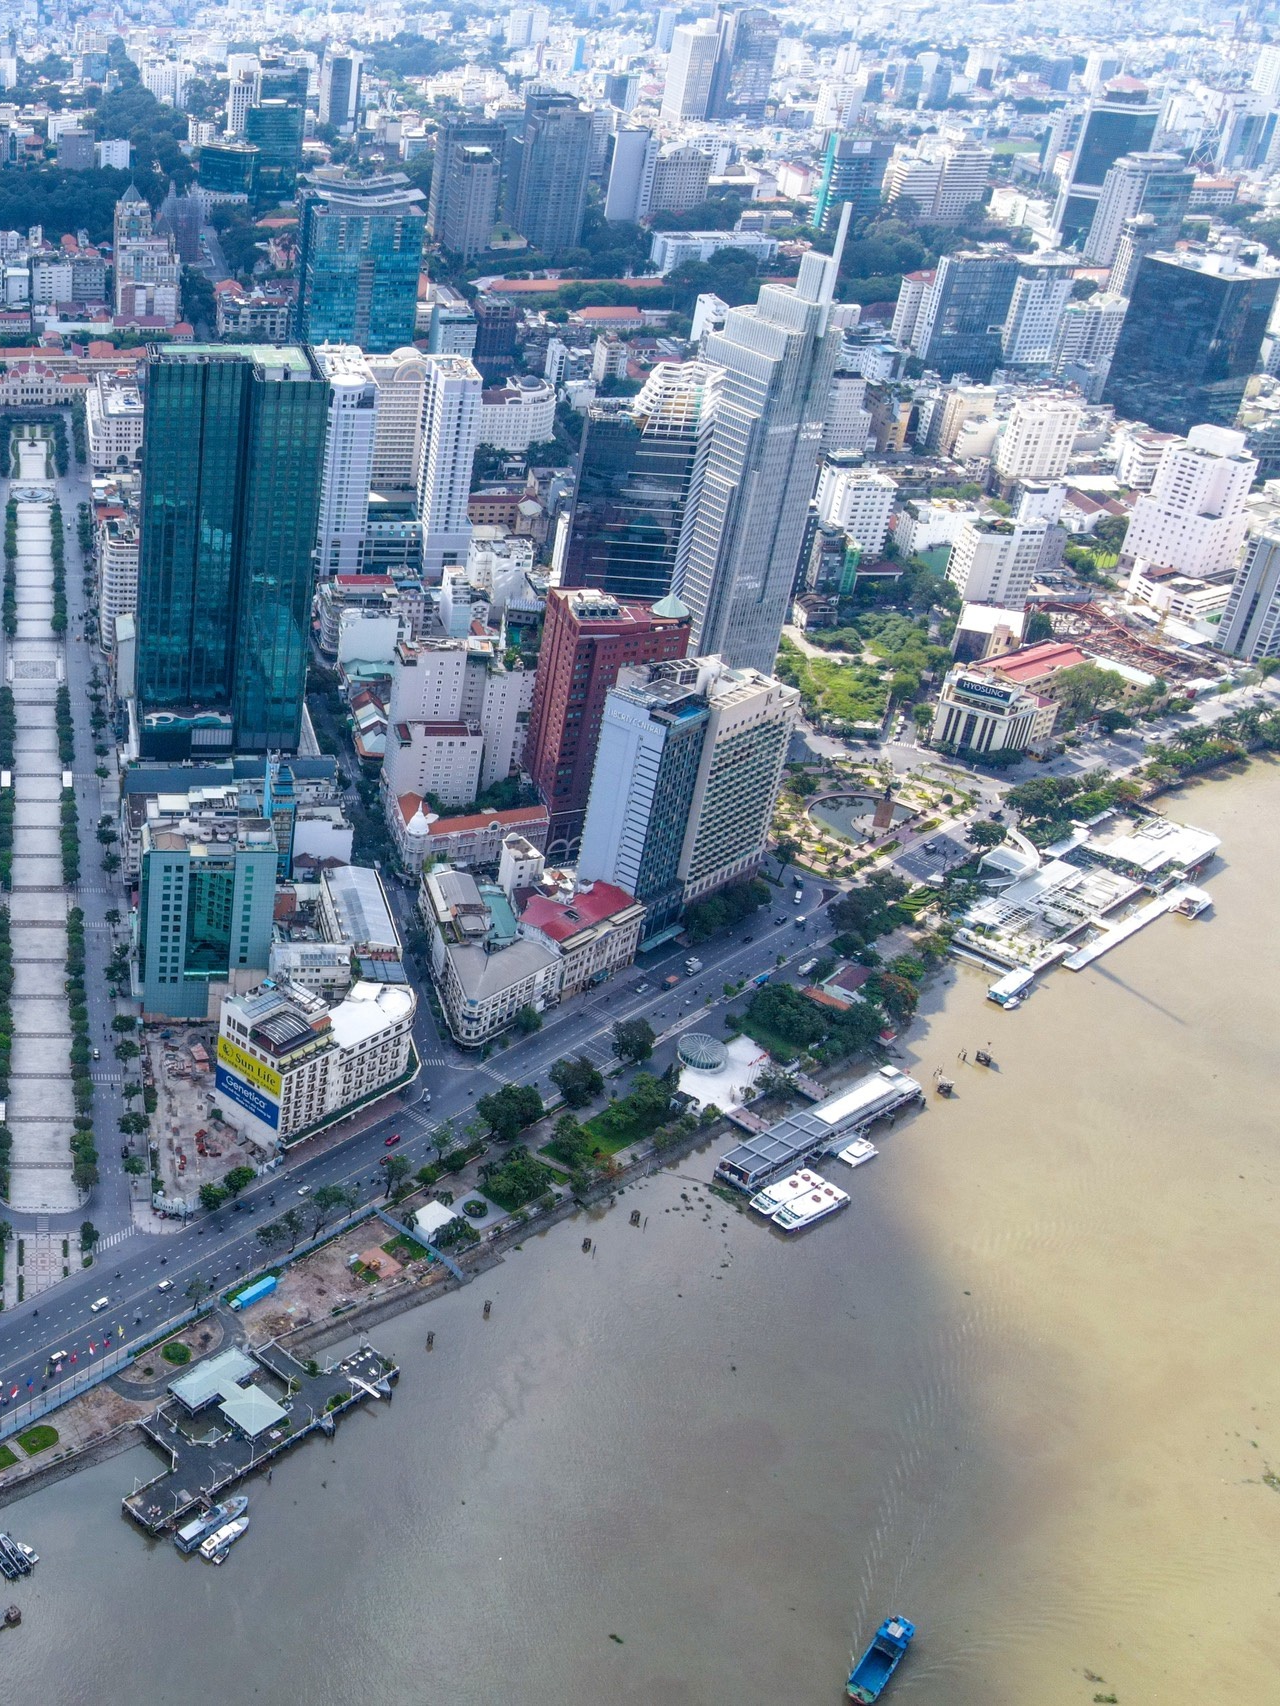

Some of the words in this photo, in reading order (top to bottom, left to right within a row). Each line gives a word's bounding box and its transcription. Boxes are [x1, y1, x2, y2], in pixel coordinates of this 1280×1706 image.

[963, 681, 1004, 698] HYOSUNG
[608, 708, 633, 723] LIBERTY
[633, 718, 663, 737] CENTRAL
[235, 1053, 254, 1072] Sun
[257, 1068, 276, 1087] Life
[225, 1075, 266, 1109] Genetica
